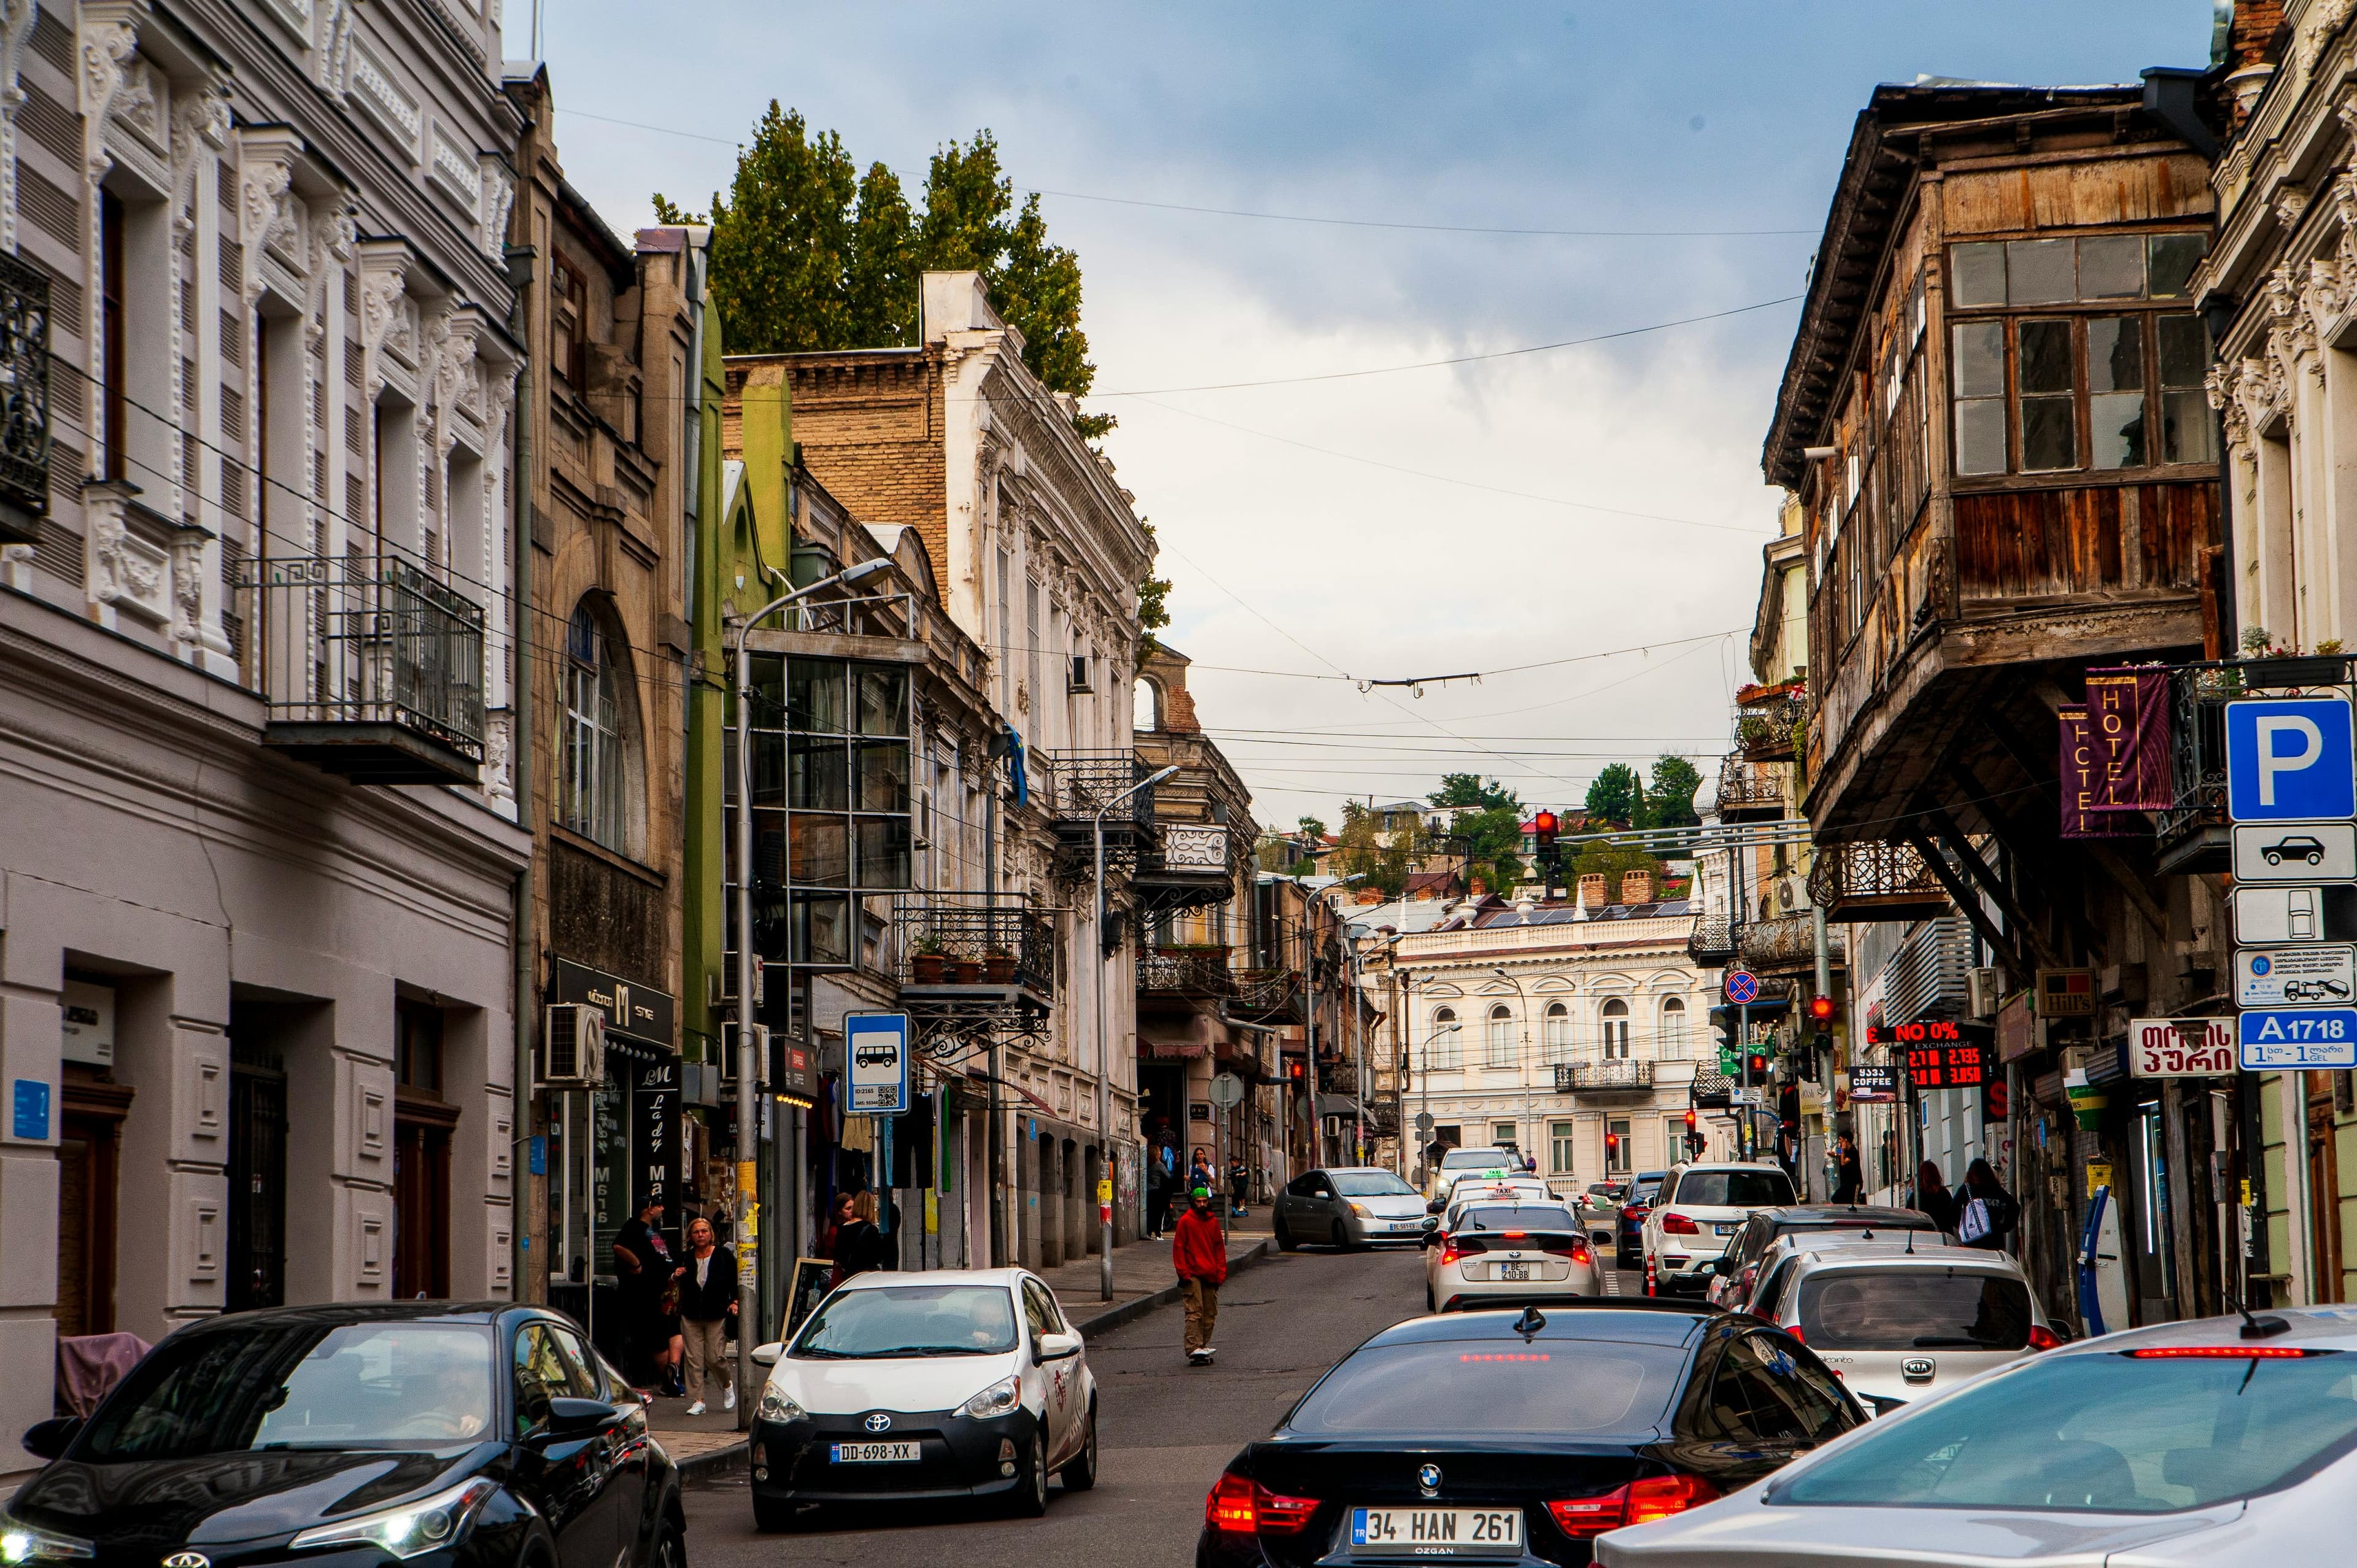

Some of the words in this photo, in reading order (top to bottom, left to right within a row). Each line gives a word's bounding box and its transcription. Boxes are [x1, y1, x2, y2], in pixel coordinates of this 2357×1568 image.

[2103, 690, 2123, 805] HOTEL
[2255, 716, 2323, 805] P
[2048, 995, 2091, 1011] Hill's
[1895, 1024, 1925, 1041] NO
[1930, 1022, 1959, 1039] 0%
[2142, 1024, 2231, 1048] თოის
[1915, 1041, 1973, 1049] EXCHANGE
[2255, 1047, 2266, 1062] 1
[2297, 1046, 2308, 1062] 1
[2143, 1048, 2232, 1072] პური
[649, 1095, 664, 1153] Lady
[1503, 1270, 1528, 1279] 210-BB
[842, 1444, 909, 1460] DD-698-XX
[1369, 1513, 1396, 1540] 34
[1412, 1513, 1457, 1540] HAN
[1473, 1513, 1514, 1541] 261
